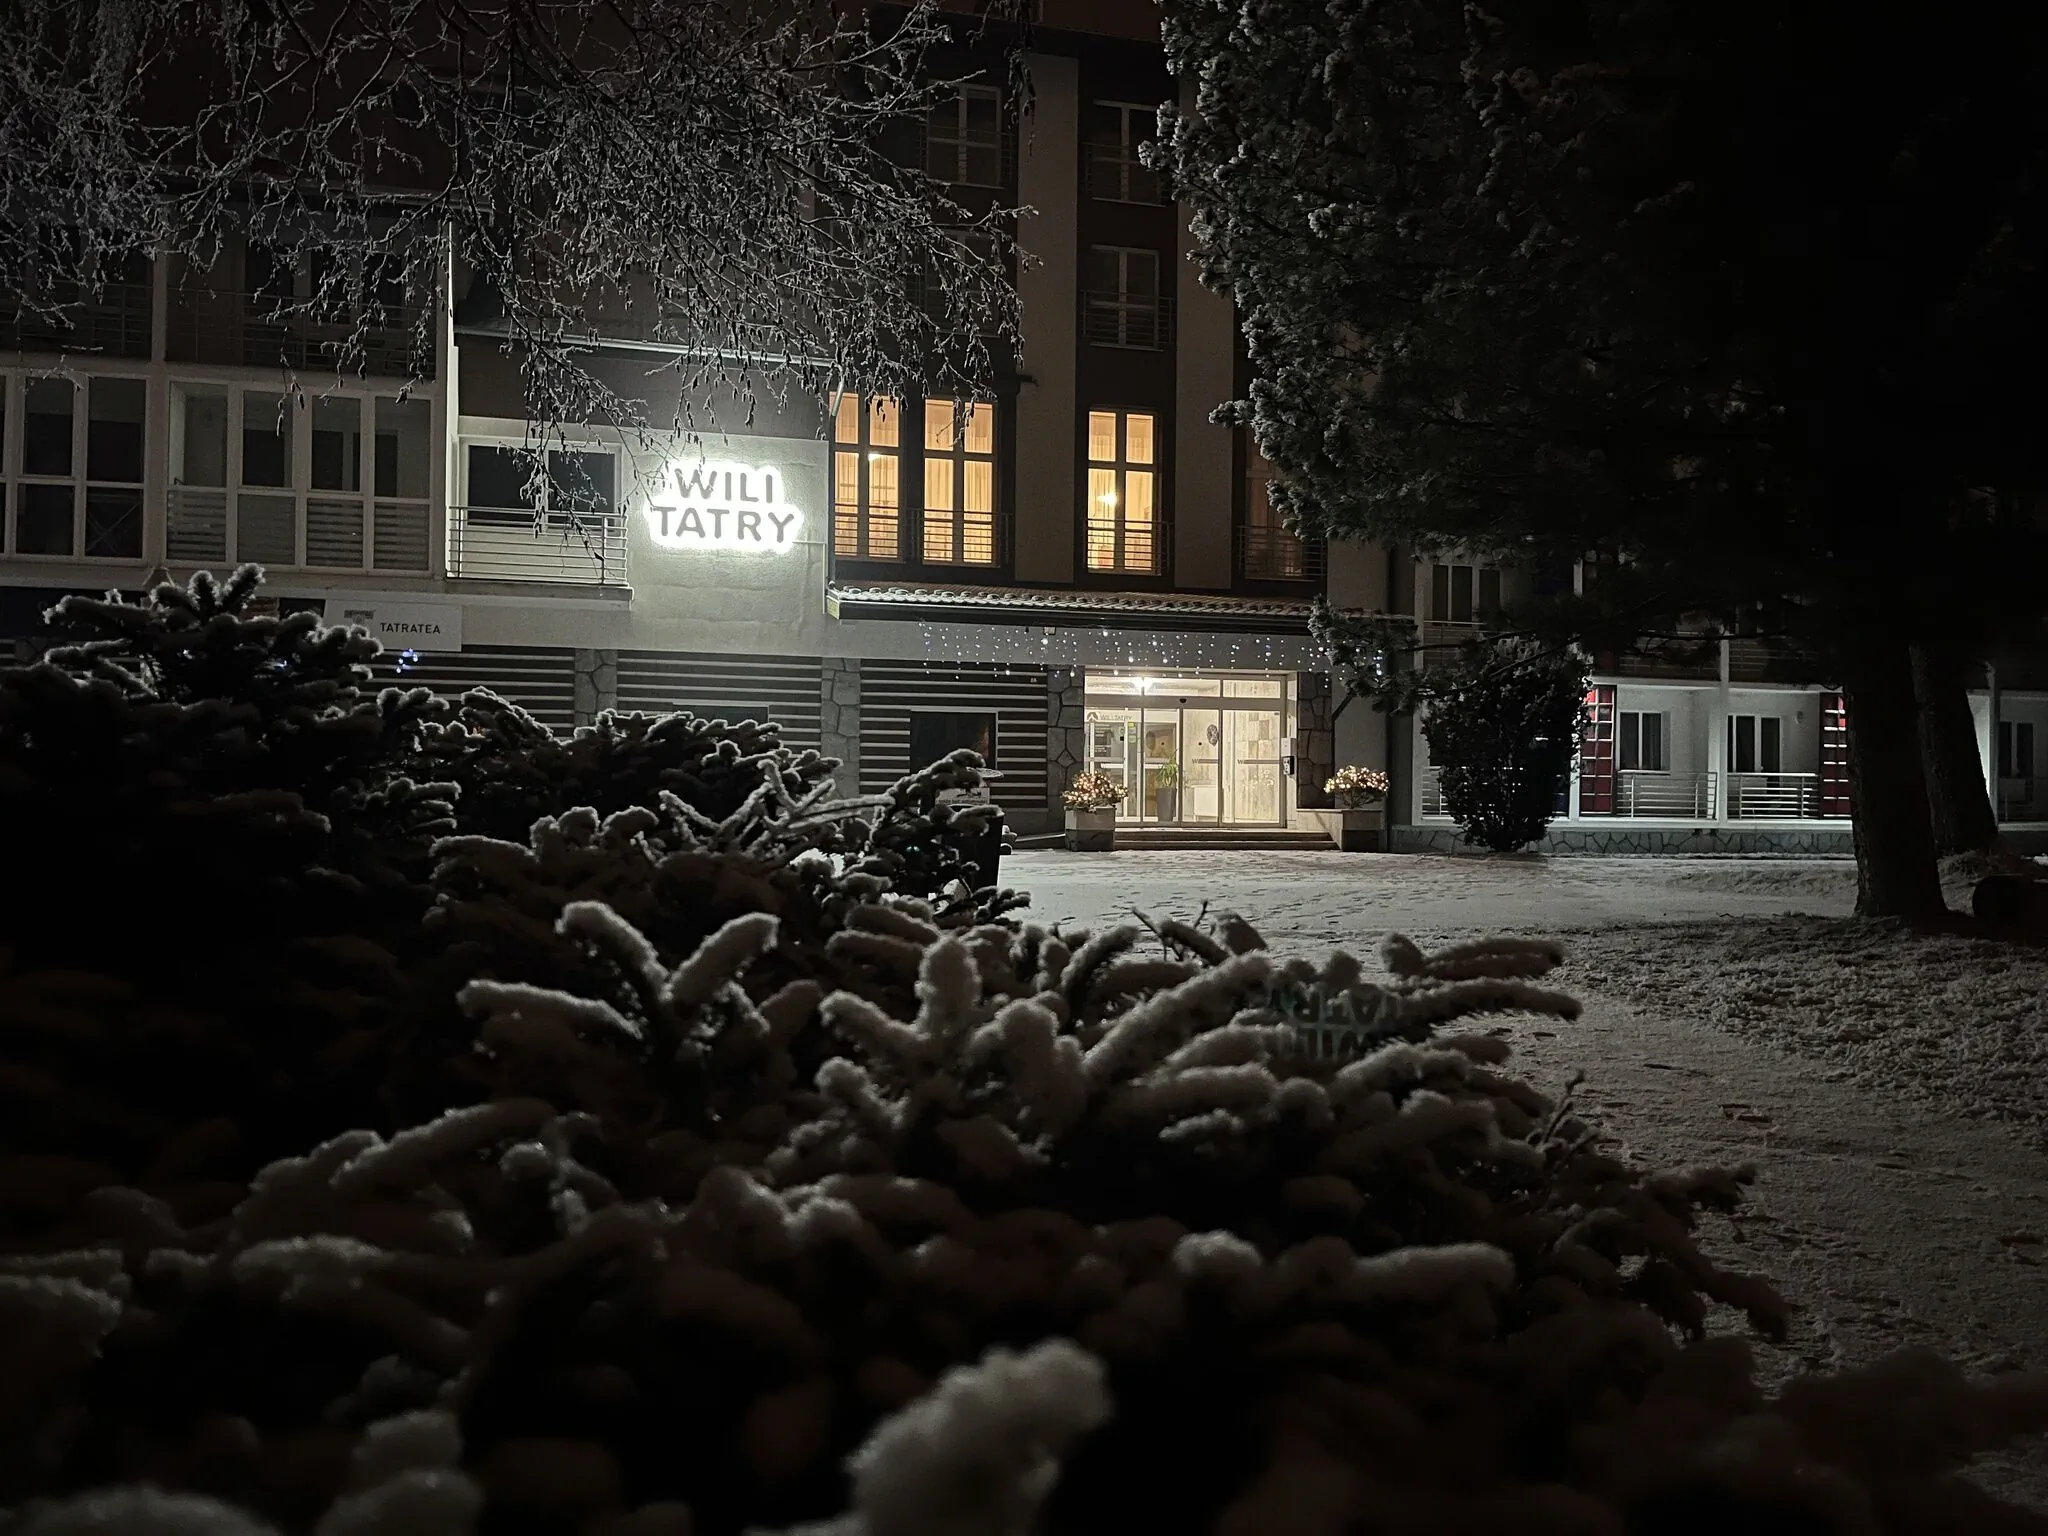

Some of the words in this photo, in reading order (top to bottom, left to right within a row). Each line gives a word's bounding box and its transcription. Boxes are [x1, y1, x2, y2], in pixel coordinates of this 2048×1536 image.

[674, 468, 773, 504] WILI
[653, 506, 795, 543] TATRY
[379, 622, 441, 635] TATRATEA
